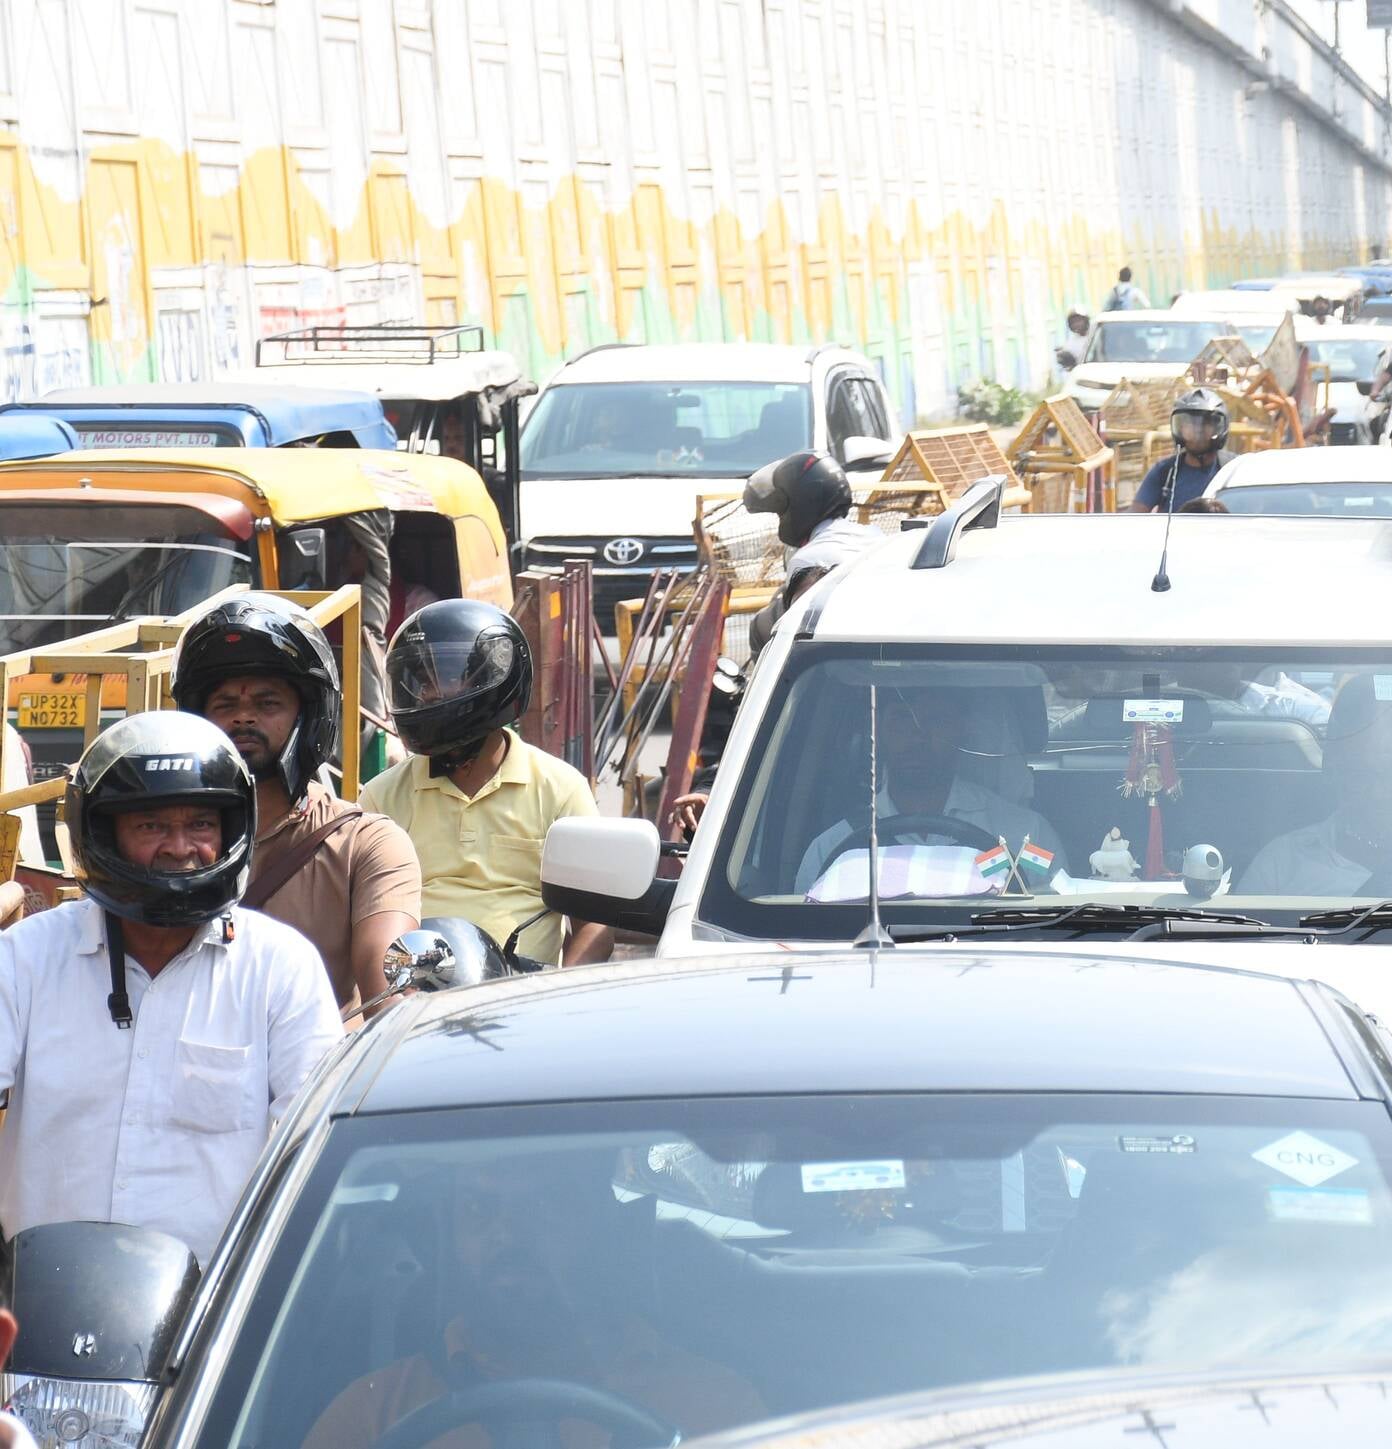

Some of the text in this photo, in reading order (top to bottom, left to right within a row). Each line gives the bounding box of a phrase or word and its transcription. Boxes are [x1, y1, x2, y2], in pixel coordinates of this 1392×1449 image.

[92, 432, 151, 444] MOTORS
[155, 433, 183, 445] PVT.
[188, 433, 215, 446] LTD.
[30, 695, 78, 710] UP32X
[1277, 1150, 1335, 1167] CNG
